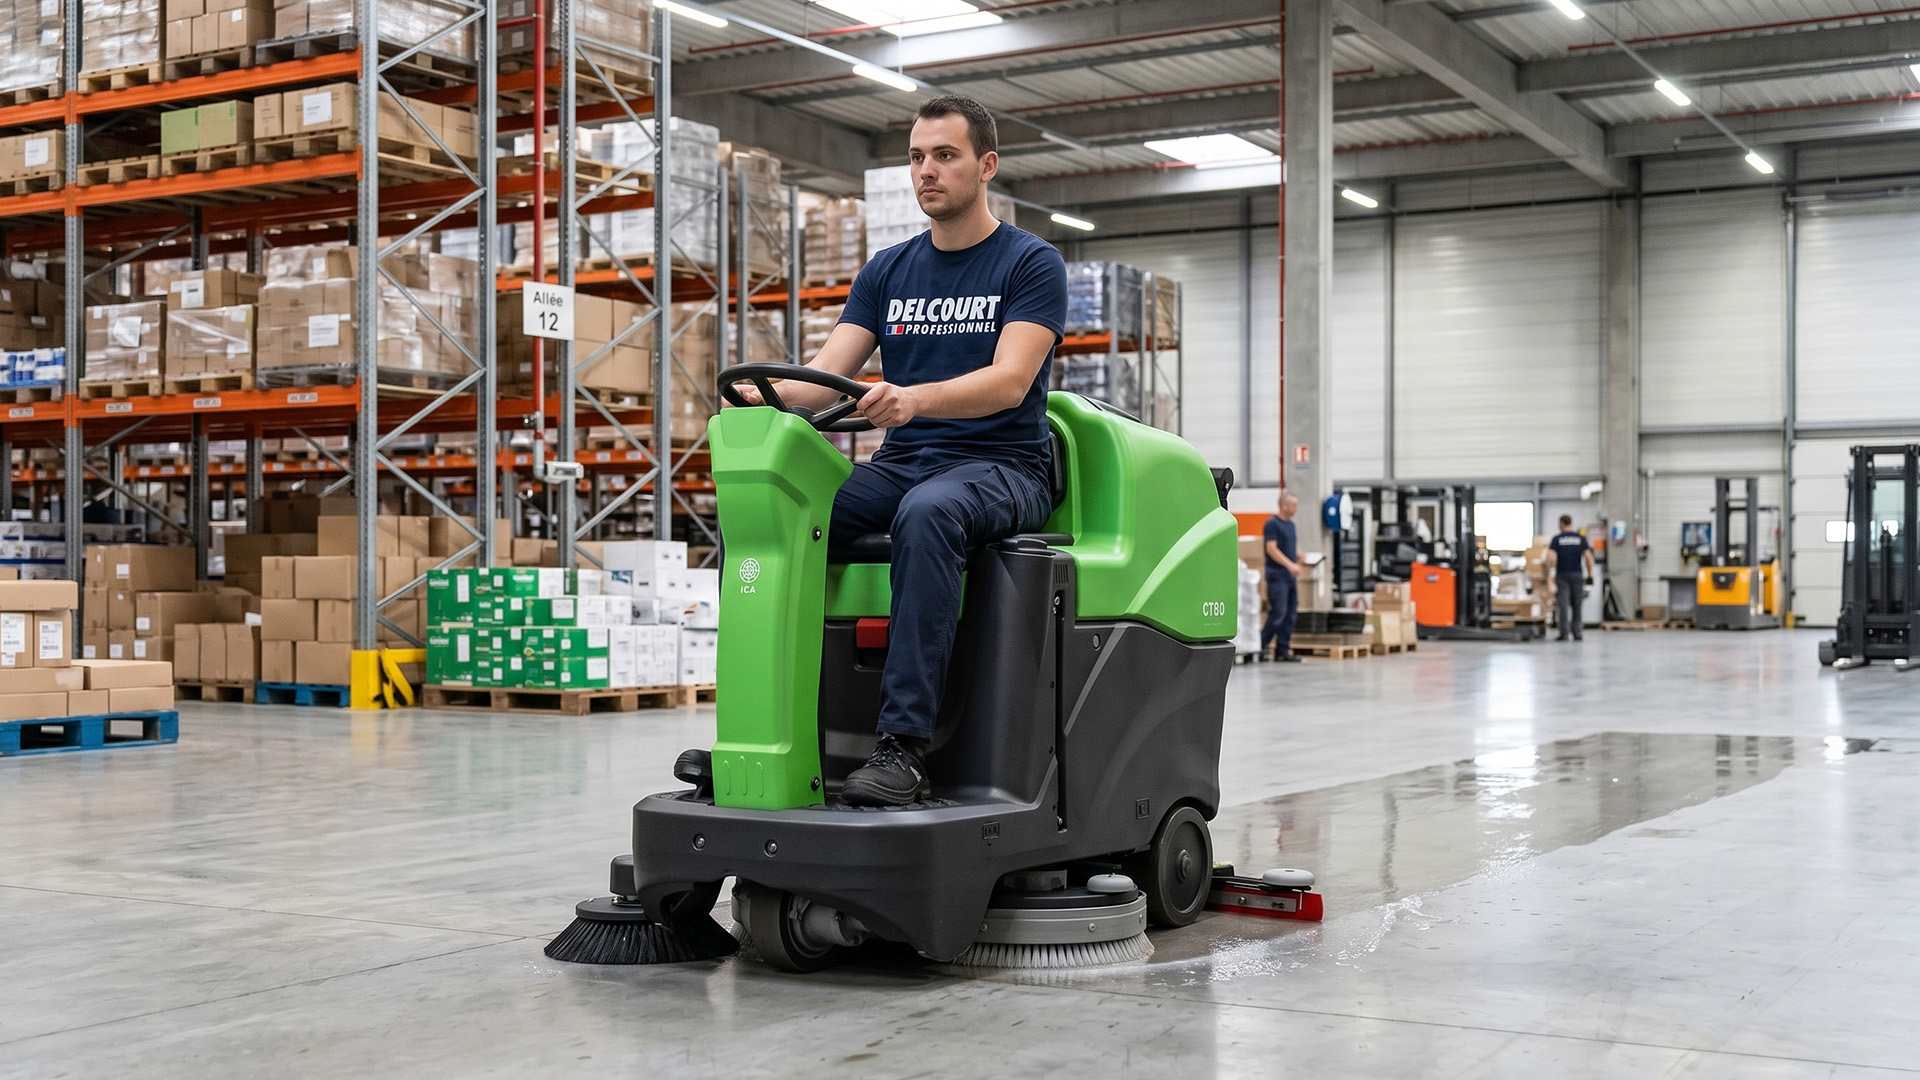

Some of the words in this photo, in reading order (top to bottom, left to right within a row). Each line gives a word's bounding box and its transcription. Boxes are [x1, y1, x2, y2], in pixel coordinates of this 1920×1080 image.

[533, 291, 563, 307] Allée
[886, 295, 1001, 323] DELCOURT
[539, 311, 558, 331] 12
[905, 321, 996, 335] PROFESSIONNEL
[740, 585, 756, 594] ICA
[1202, 601, 1225, 616] CT80
